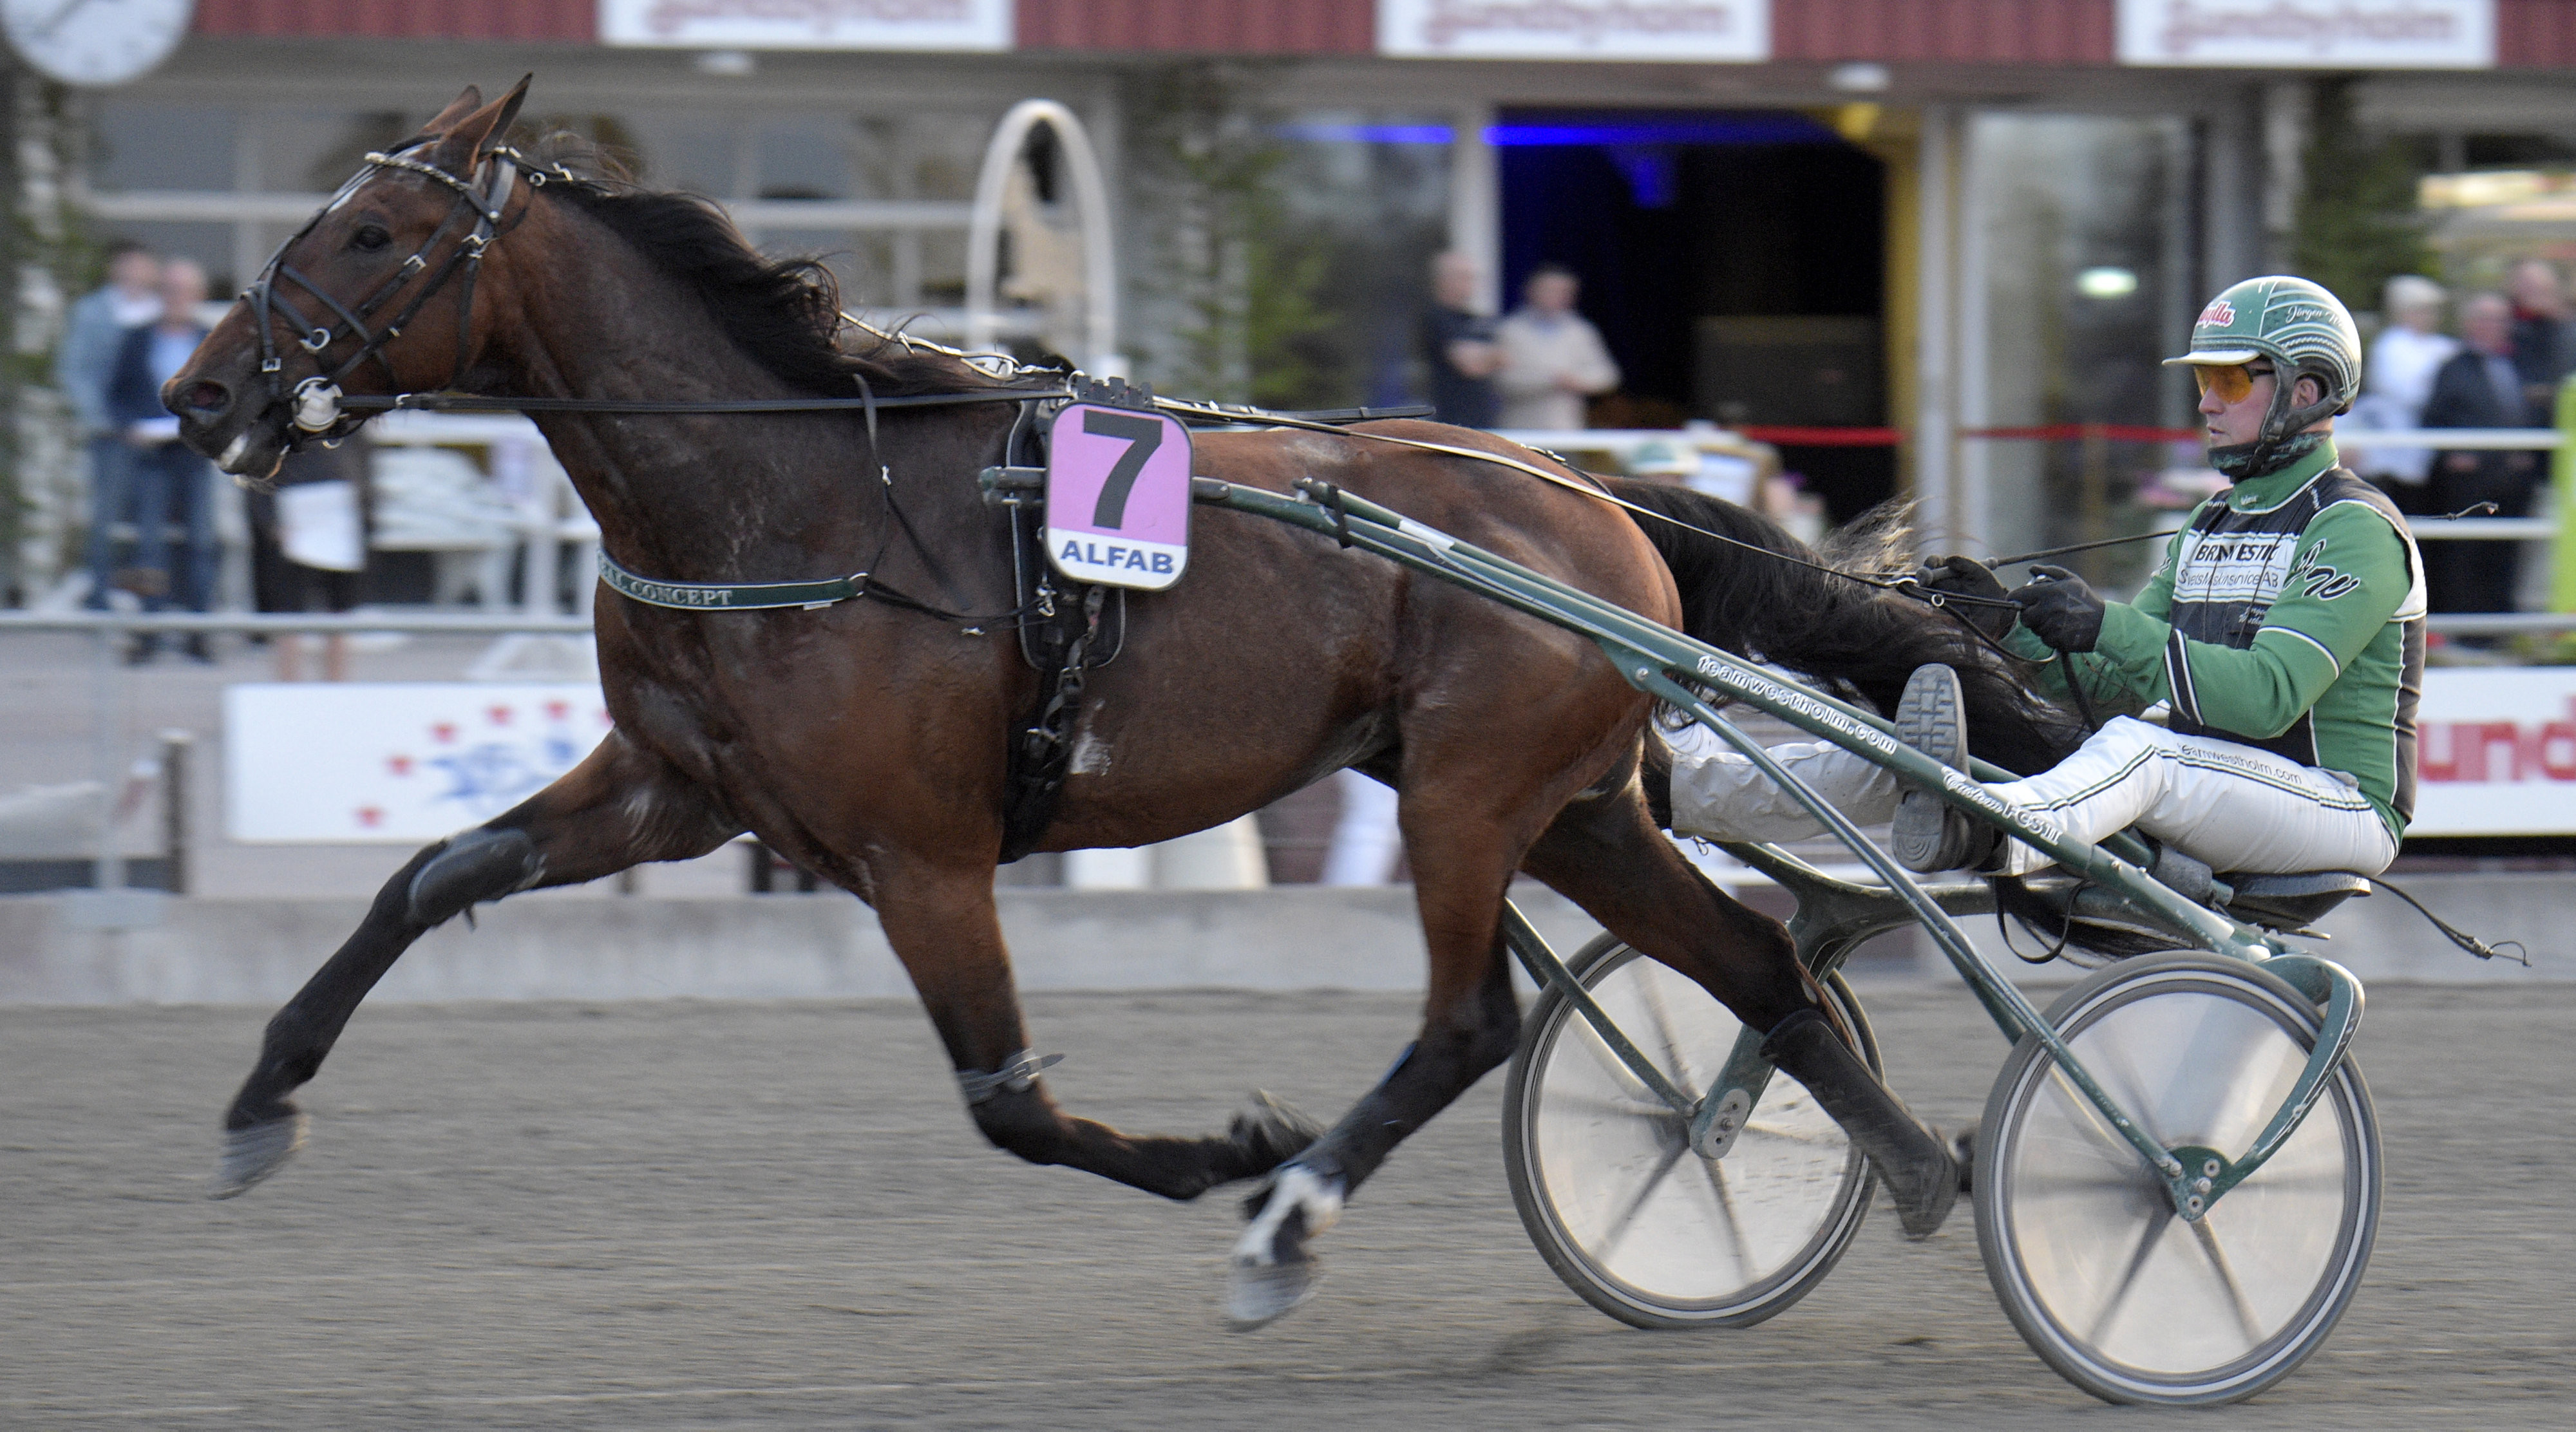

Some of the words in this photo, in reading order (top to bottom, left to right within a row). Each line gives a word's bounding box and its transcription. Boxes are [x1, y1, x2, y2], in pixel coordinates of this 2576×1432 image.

[2286, 305, 2322, 324] Jörgen
[1083, 409, 1164, 530] 7
[1061, 540, 1174, 574] ALFAB
[630, 581, 733, 606] CONCEPT
[2261, 571, 2278, 588] AB
[1696, 655, 1898, 756] teamwestholm.com
[2178, 744, 2303, 785] eamwestholm.com
